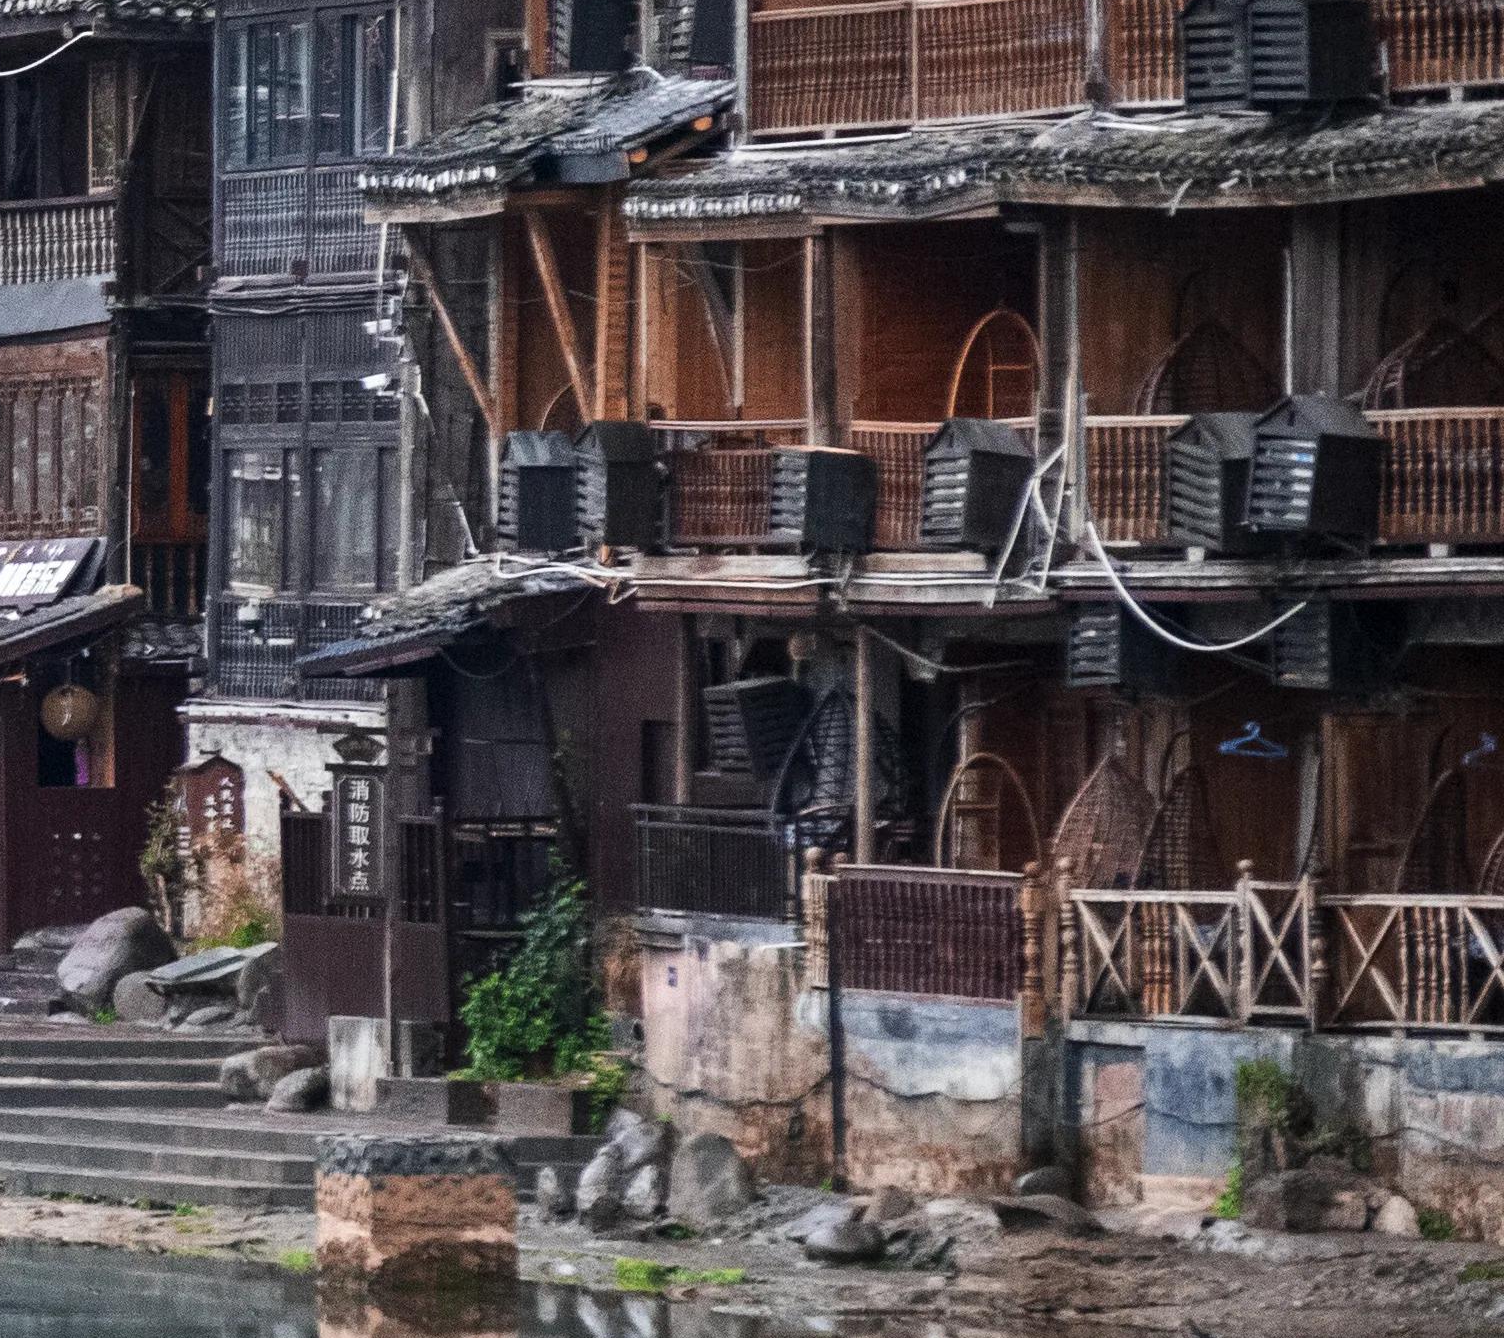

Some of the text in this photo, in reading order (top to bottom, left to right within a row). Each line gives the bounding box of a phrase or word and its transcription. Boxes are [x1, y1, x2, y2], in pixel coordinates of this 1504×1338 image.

[349, 779, 370, 892] 消防取水点
